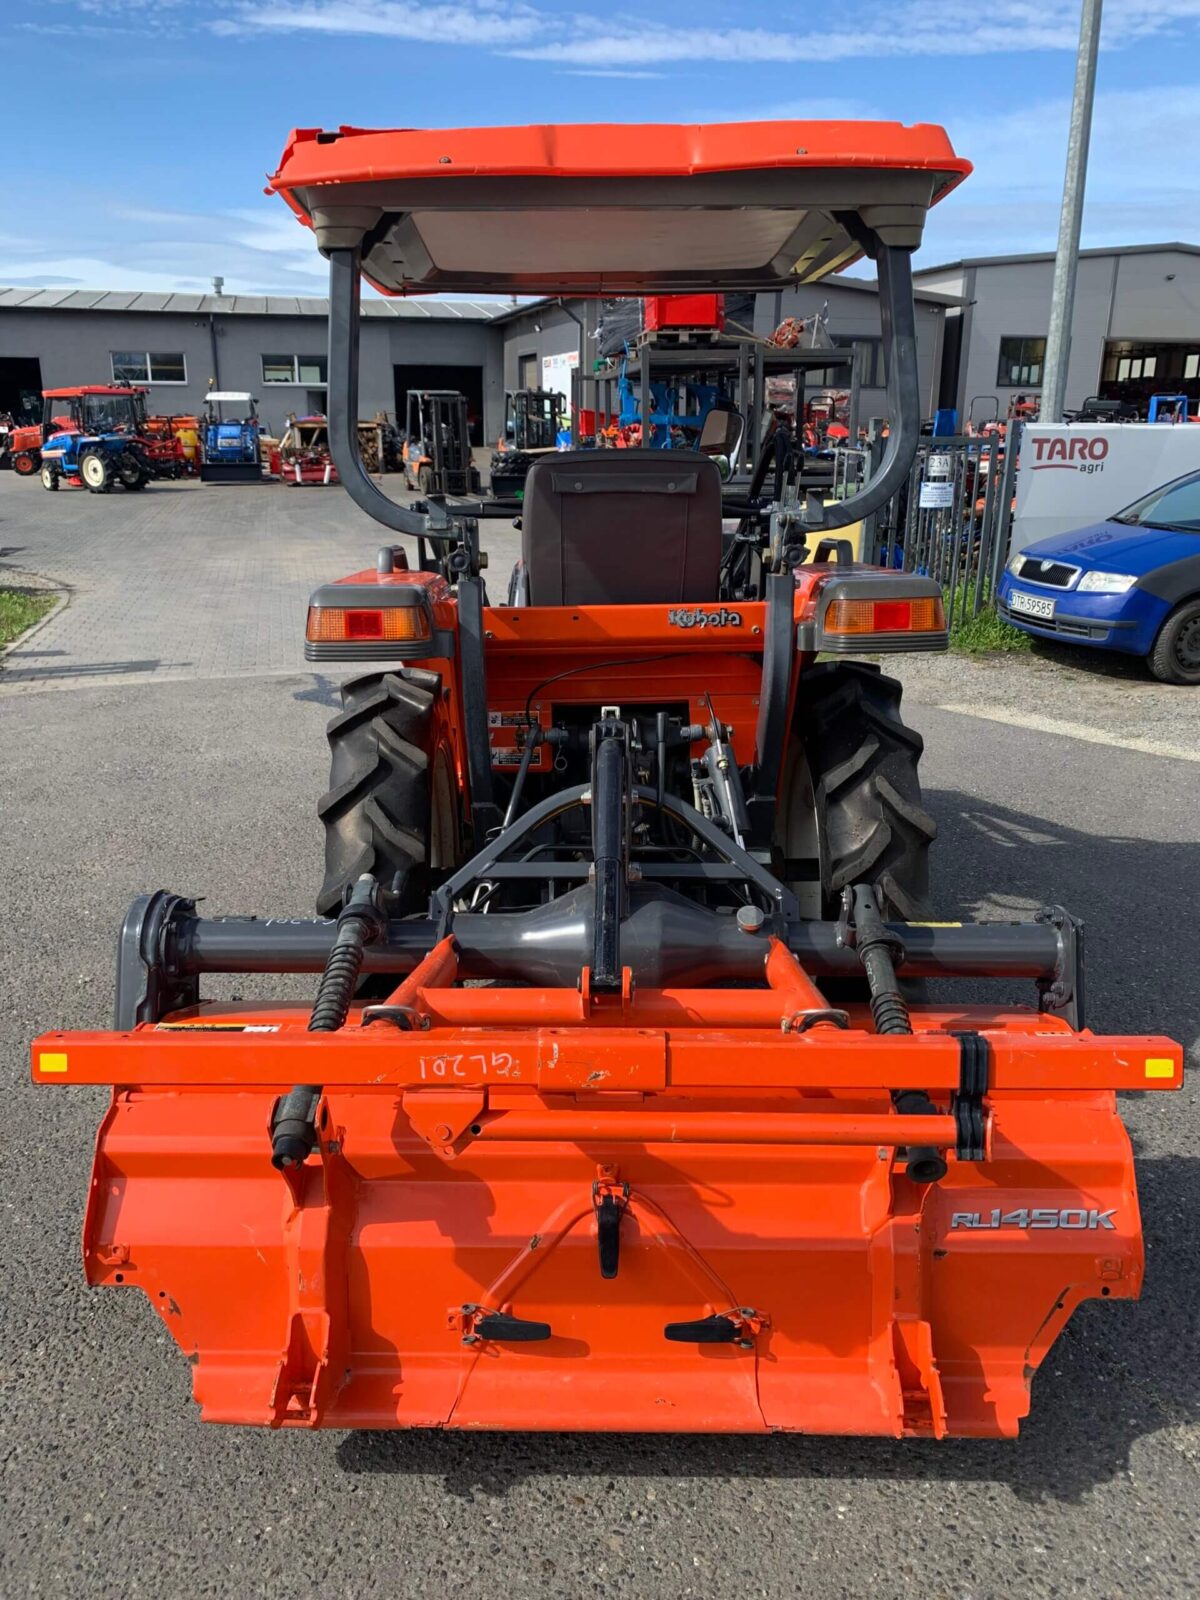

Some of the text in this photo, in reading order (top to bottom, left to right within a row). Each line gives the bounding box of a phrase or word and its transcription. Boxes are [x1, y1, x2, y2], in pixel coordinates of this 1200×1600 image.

[1032, 437, 1109, 460] TARO
[1080, 462, 1104, 474] agri
[1027, 598, 1052, 616] 59585
[668, 608, 742, 629] Kubota
[951, 1208, 1118, 1230] RL1450K
